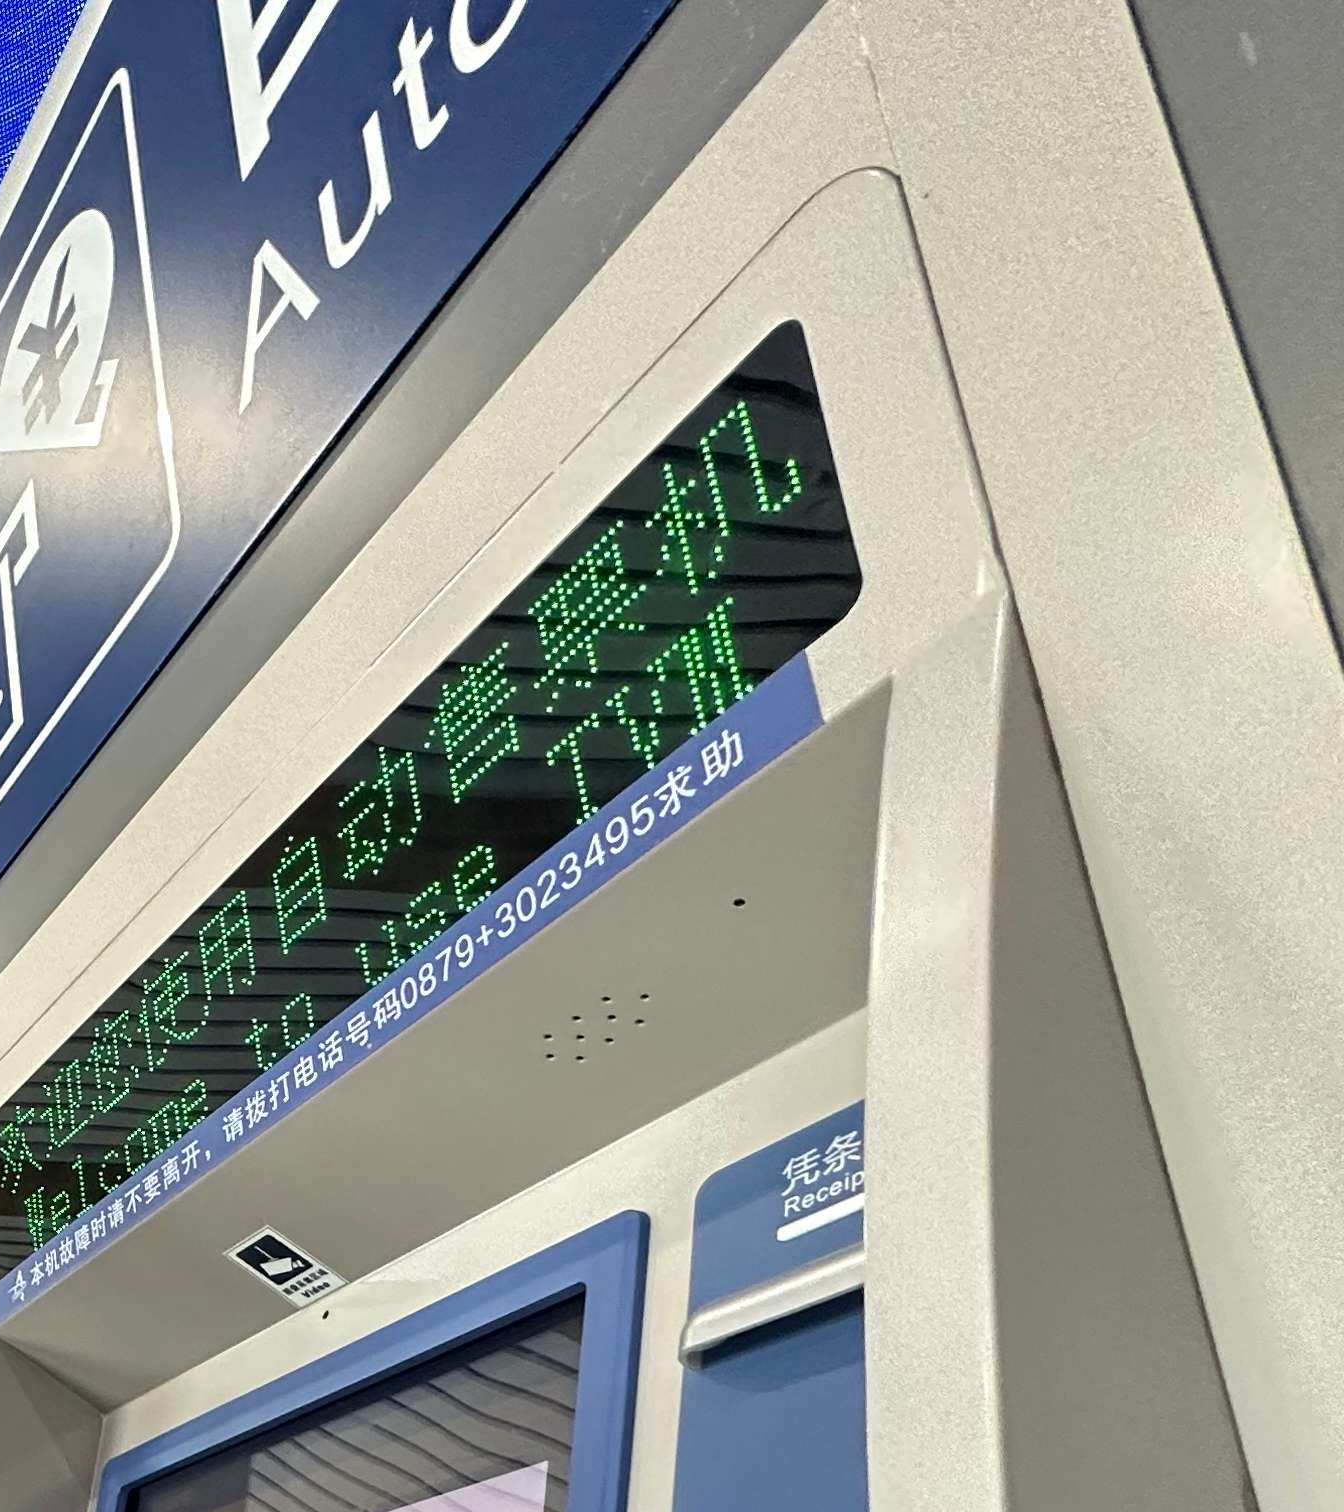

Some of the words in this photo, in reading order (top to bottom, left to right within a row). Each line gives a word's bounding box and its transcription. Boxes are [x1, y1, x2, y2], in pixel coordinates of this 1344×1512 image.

[24, 1078, 209, 1252] Welcome
[245, 993, 314, 1070] to
[355, 846, 496, 985] use
[545, 597, 754, 825] TVM
[781, 1130, 862, 1197] 凭条
